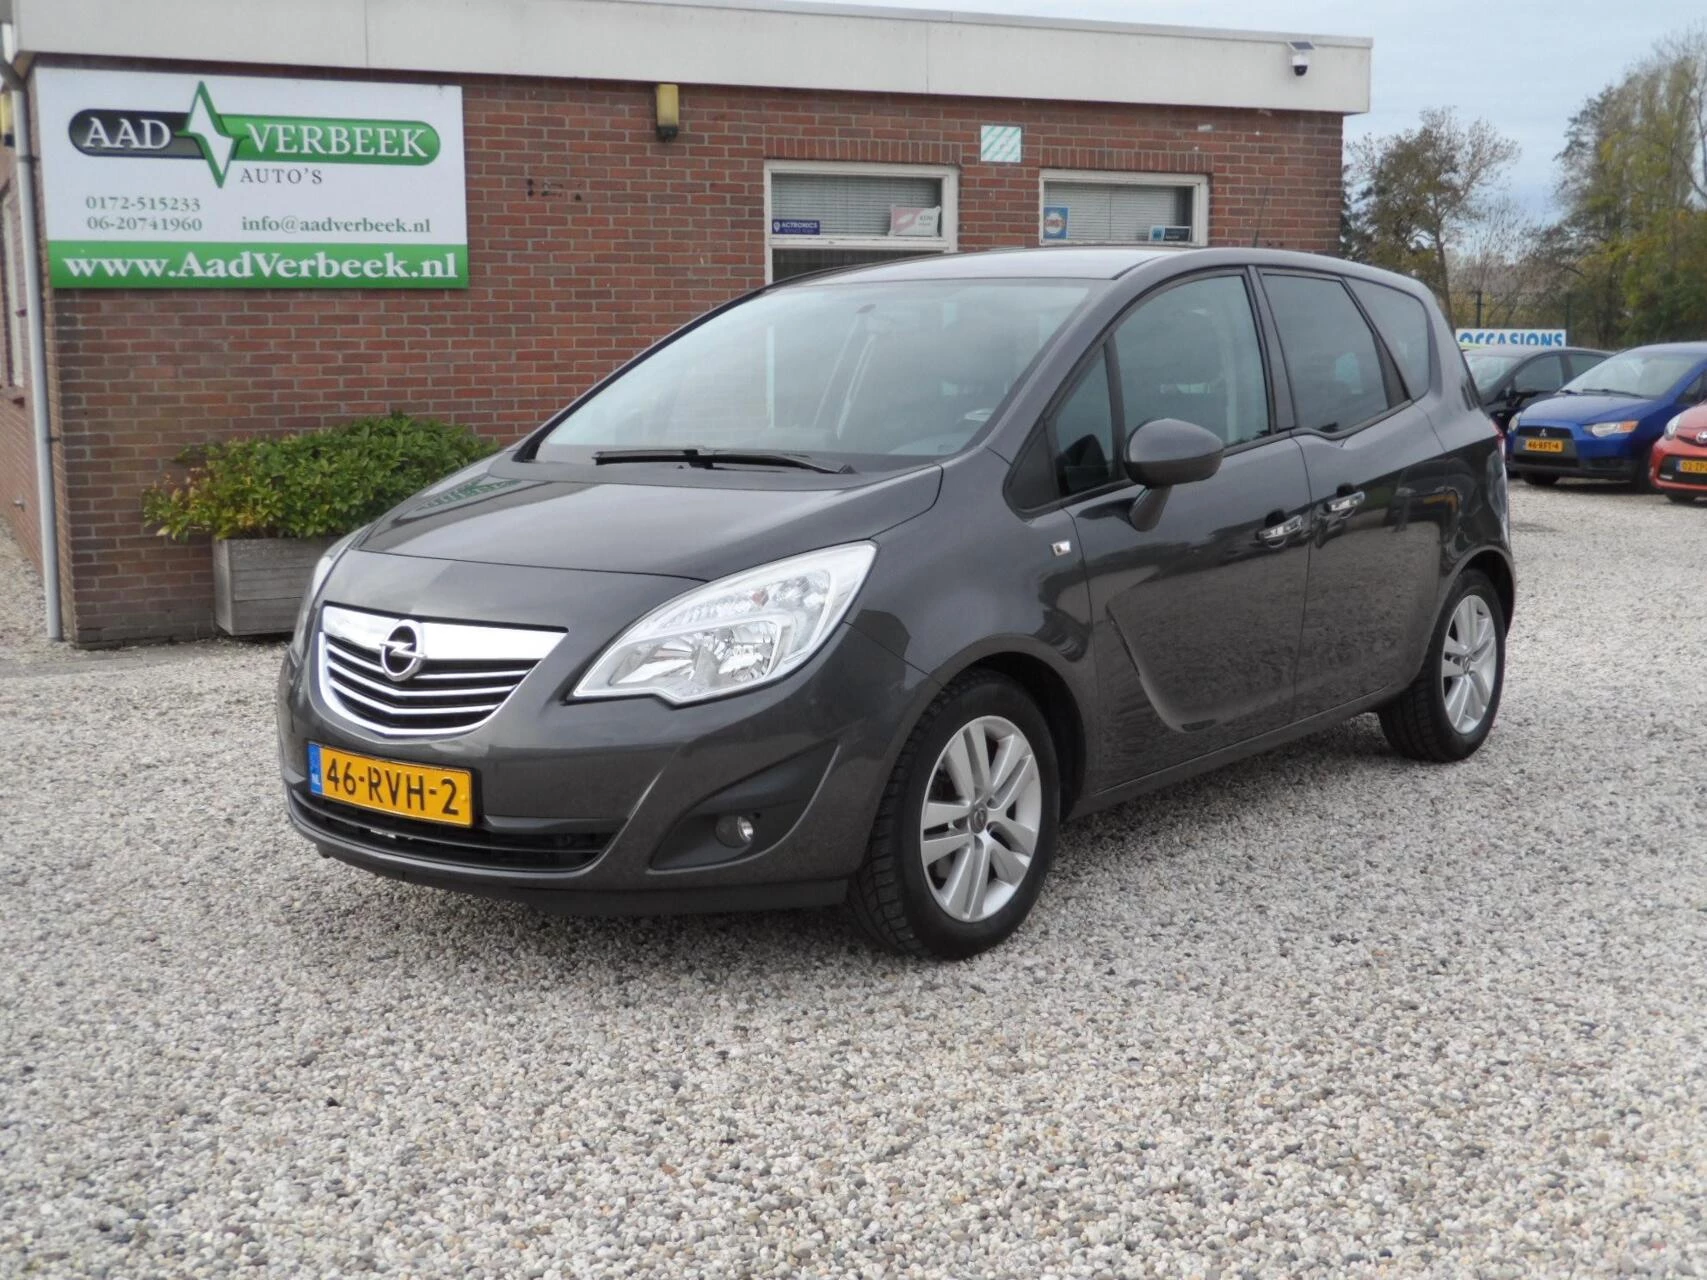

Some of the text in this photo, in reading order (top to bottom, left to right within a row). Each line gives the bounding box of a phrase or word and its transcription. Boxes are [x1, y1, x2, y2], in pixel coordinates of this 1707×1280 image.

[82, 117, 429, 158] AAD VERBEEK
[240, 168, 322, 185] AUTO'S
[86, 196, 200, 212] 0172-515233
[87, 216, 202, 231] 06-20741960
[241, 215, 431, 234] info@aadverbeek.nl
[62, 251, 458, 280] www.AadVerbeek.nl
[327, 757, 459, 816] 46-RVH-2
